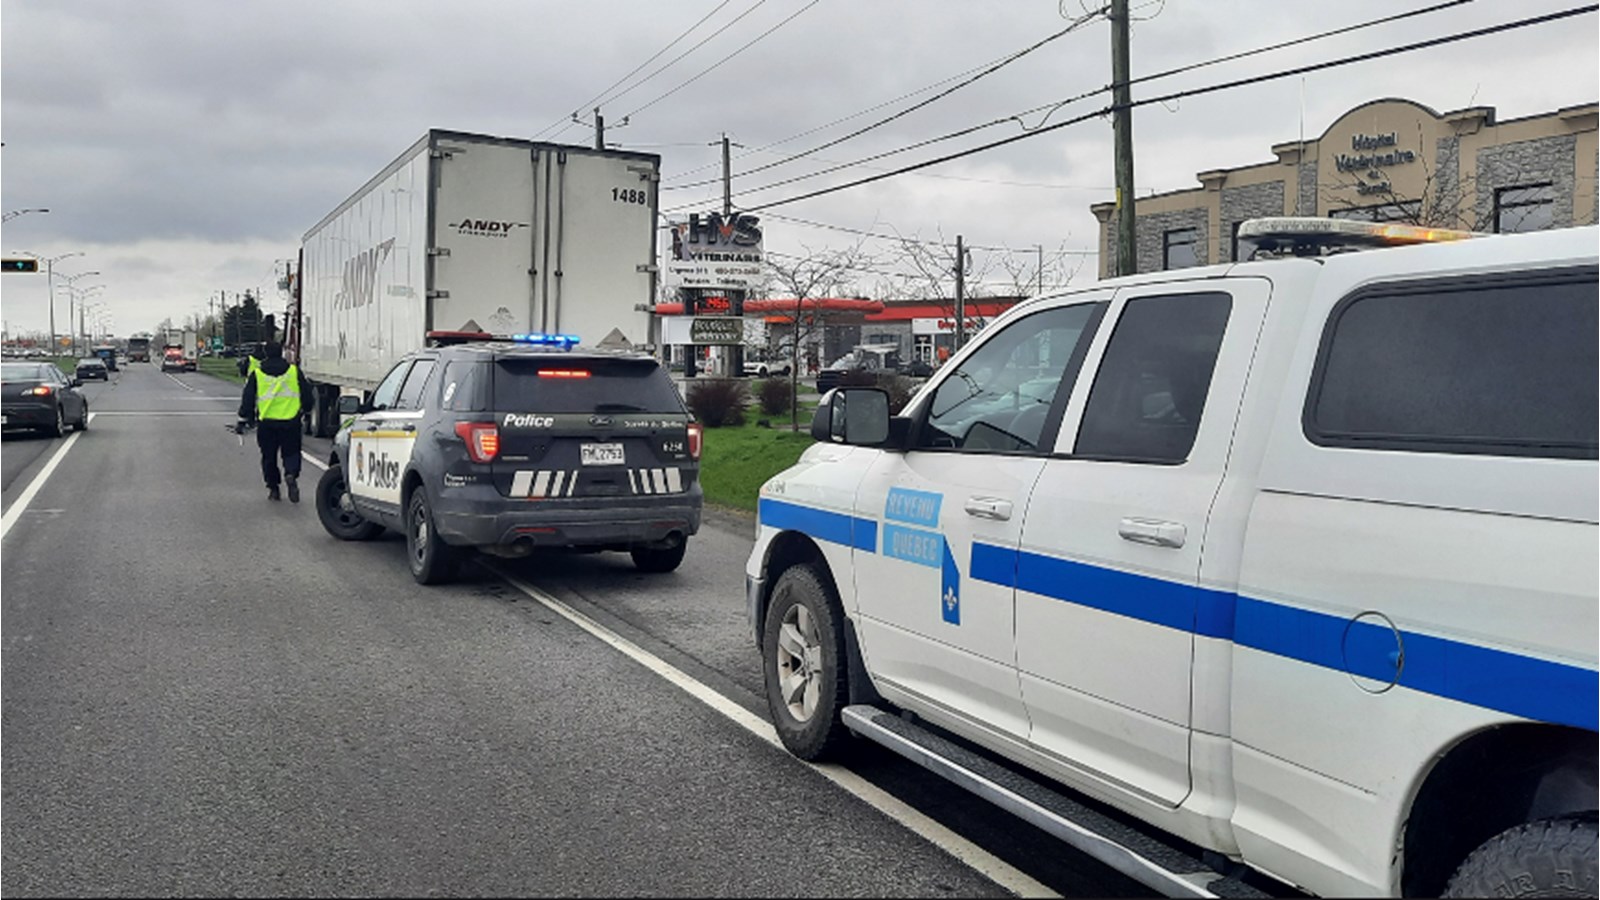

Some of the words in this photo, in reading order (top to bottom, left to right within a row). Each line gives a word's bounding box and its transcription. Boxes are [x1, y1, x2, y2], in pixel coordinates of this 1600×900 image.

[611, 187, 646, 205] 1488
[459, 218, 514, 232] ANDY
[688, 212, 762, 246] HVS
[334, 237, 395, 311] ANDY
[503, 413, 554, 427] Police
[366, 450, 400, 490] Police
[888, 492, 935, 521] REVENU
